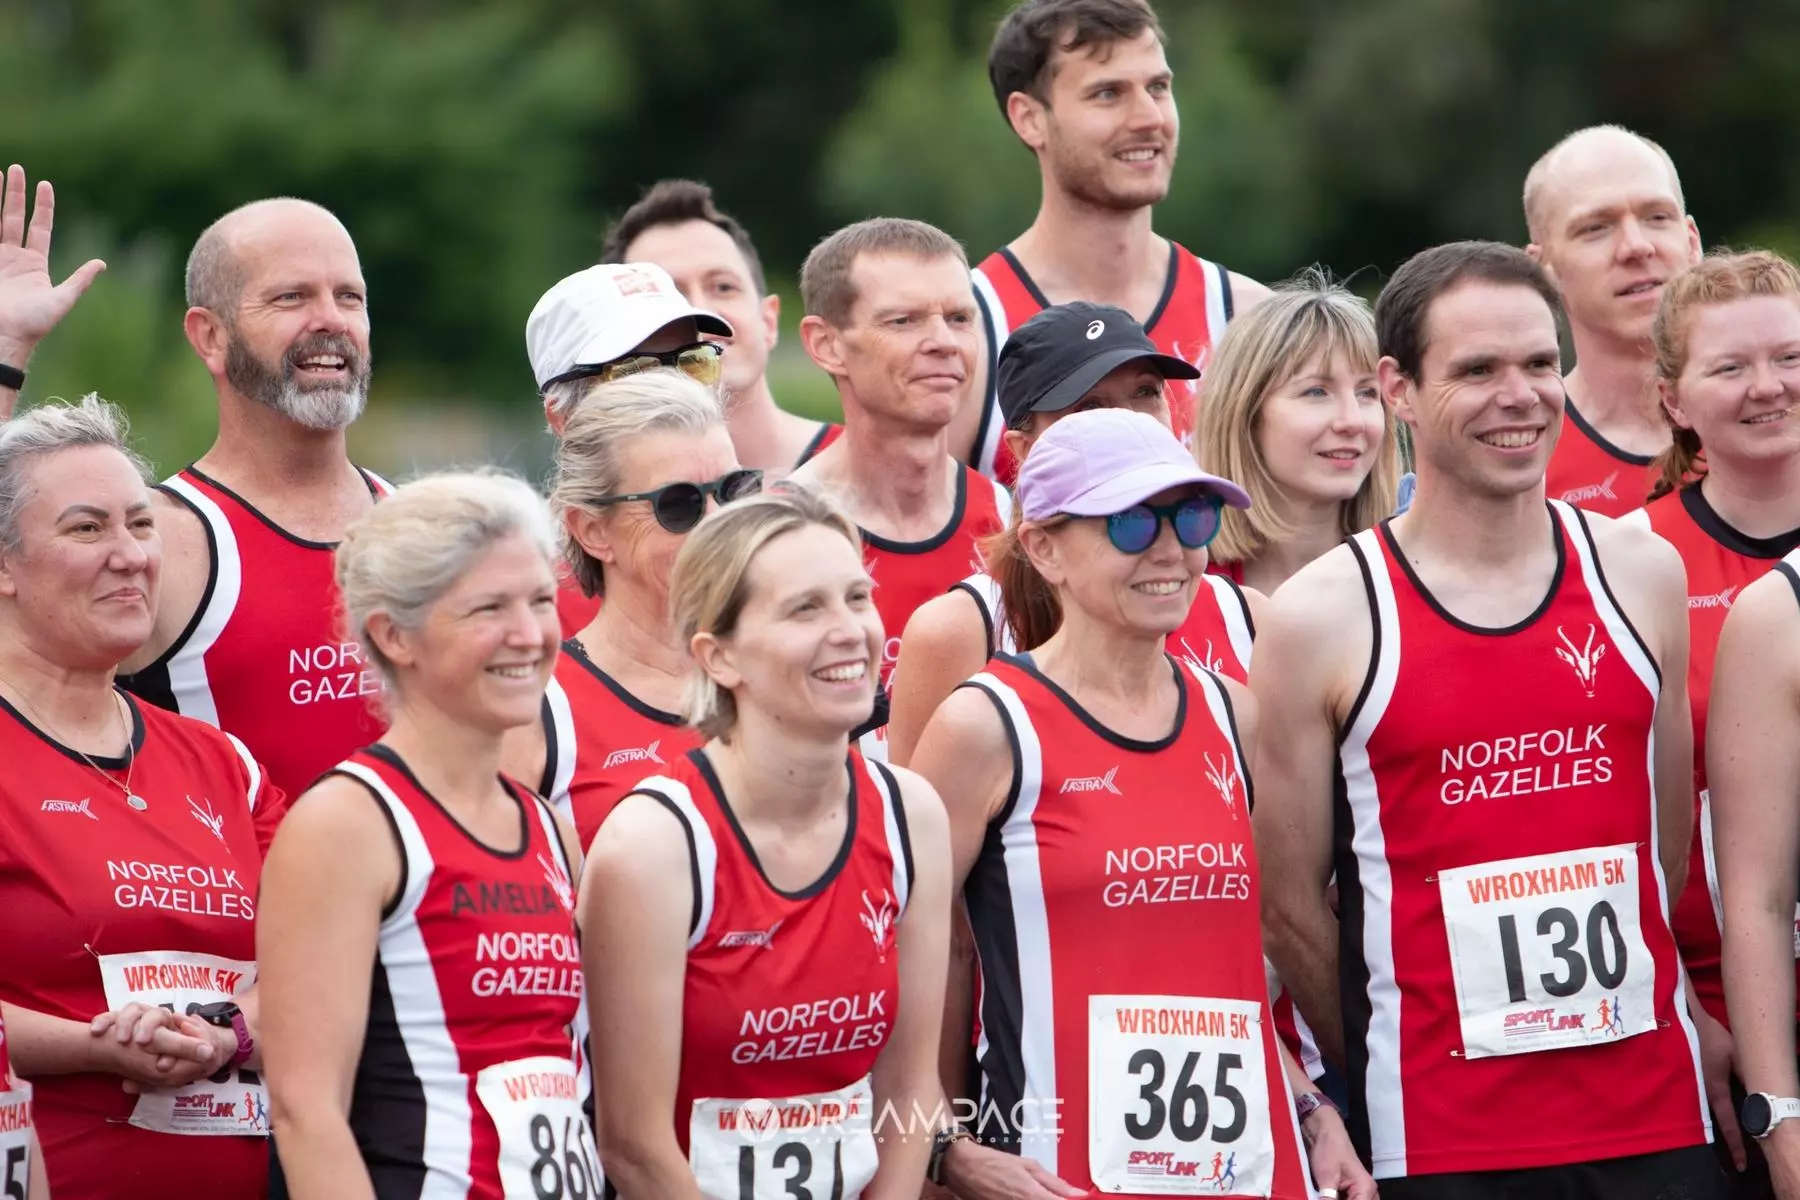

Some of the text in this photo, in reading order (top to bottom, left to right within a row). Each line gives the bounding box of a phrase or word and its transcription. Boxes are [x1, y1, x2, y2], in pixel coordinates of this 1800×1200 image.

[289, 641, 366, 674] NOR
[289, 669, 380, 705] GAZE
[603, 739, 666, 769] FASTRAX
[1440, 723, 1608, 773] NORFOLK
[1060, 765, 1122, 796] FASTRAX
[1440, 756, 1613, 805] GAZELLES
[41, 797, 99, 821] FASTRAX
[106, 860, 244, 891] NORFOLK
[1105, 843, 1247, 875] NORFOLK
[1102, 873, 1251, 907] GAZELLES
[1467, 858, 1625, 904] WROXHAM 5K
[114, 884, 255, 921] GAZELLES
[451, 880, 559, 917] AMELIA
[1498, 900, 1628, 1003] 130
[123, 963, 243, 995] WROXHAM 5K
[471, 966, 584, 998] GAZELLE
[739, 989, 886, 1036] NORFOLK
[1116, 1008, 1250, 1040] WROXHAM 5K
[1504, 1008, 1585, 1031] SPORT LINK
[731, 1021, 887, 1065] GAZELLES
[174, 1094, 214, 1107] SPORT
[1124, 1048, 1248, 1144] 365
[1127, 1150, 1200, 1176] SPORT LINK
